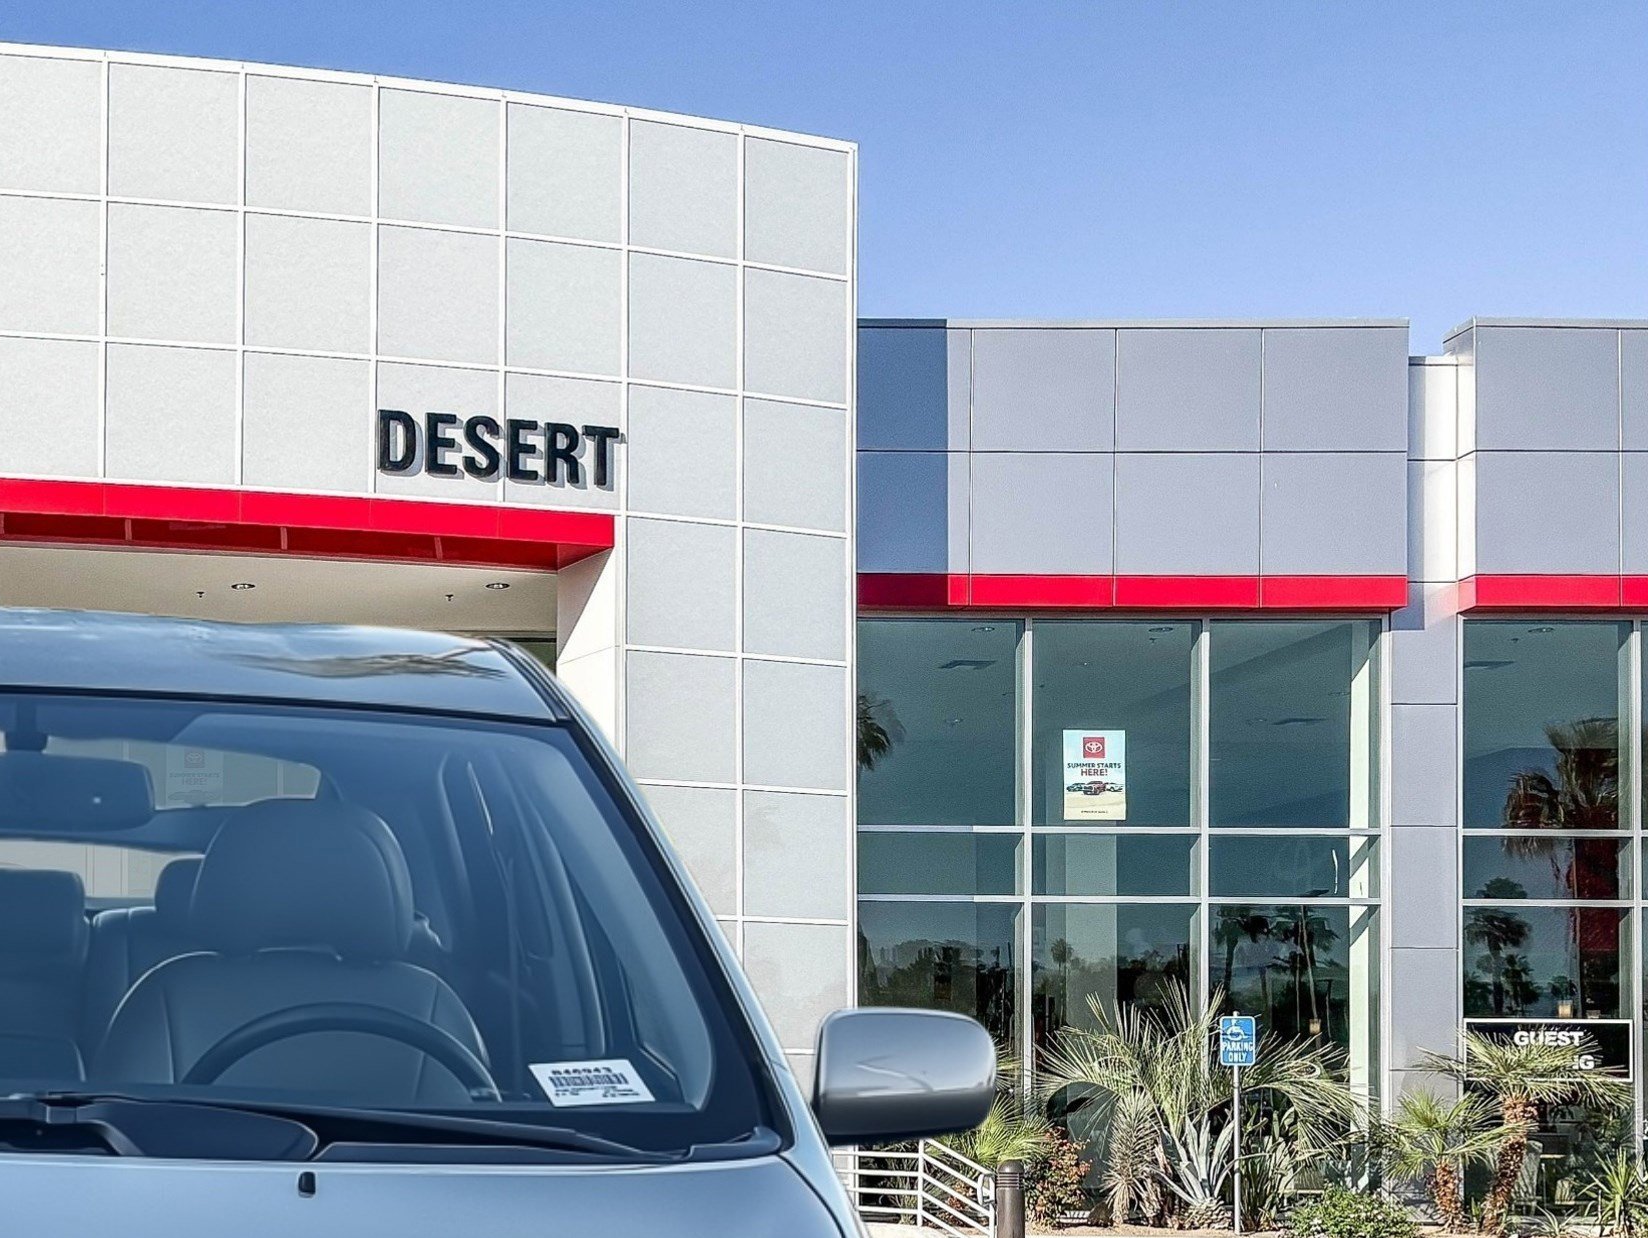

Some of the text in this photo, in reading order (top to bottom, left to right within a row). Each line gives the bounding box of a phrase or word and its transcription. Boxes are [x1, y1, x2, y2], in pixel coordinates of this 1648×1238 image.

[377, 409, 620, 486] DESERT
[1513, 1031, 1584, 1046] GUEST
[1222, 1041, 1253, 1051] PARKING
[1228, 1052, 1247, 1062] ONLY
